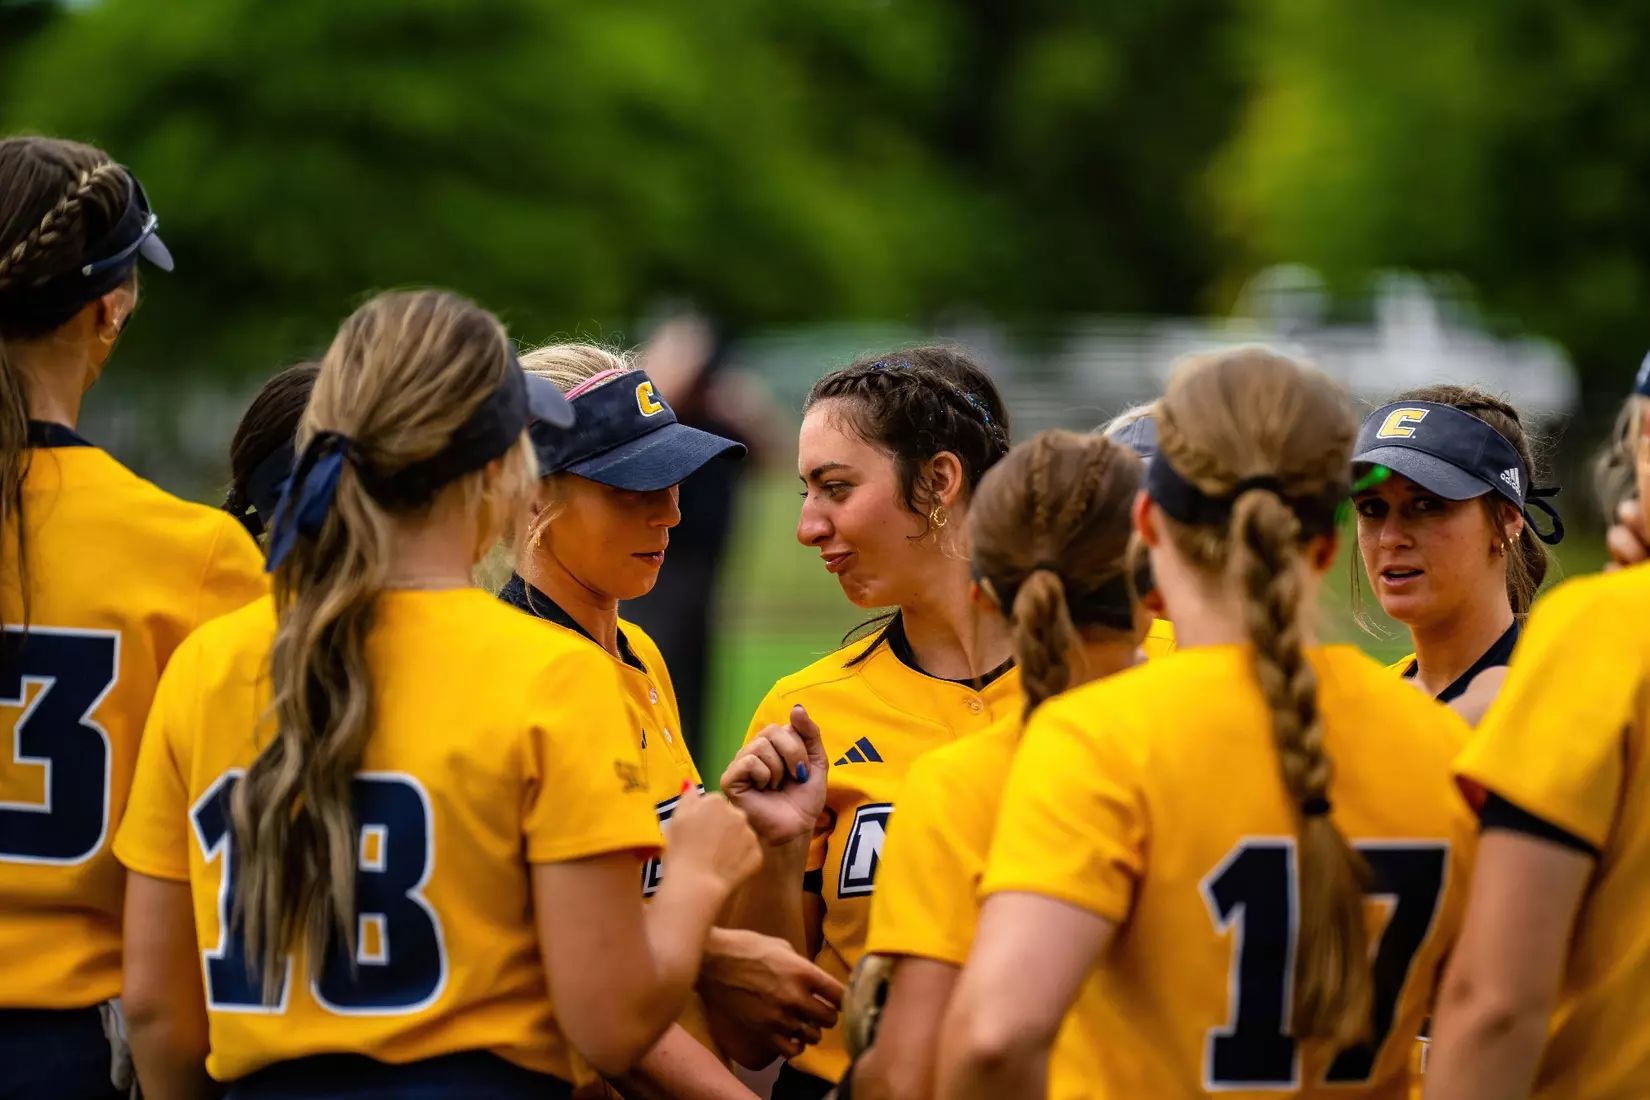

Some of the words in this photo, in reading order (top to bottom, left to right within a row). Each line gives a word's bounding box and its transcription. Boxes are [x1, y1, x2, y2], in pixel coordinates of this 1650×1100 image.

[636, 381, 664, 417] C
[188, 767, 449, 1017] 18
[1198, 836, 1451, 1091] 17
